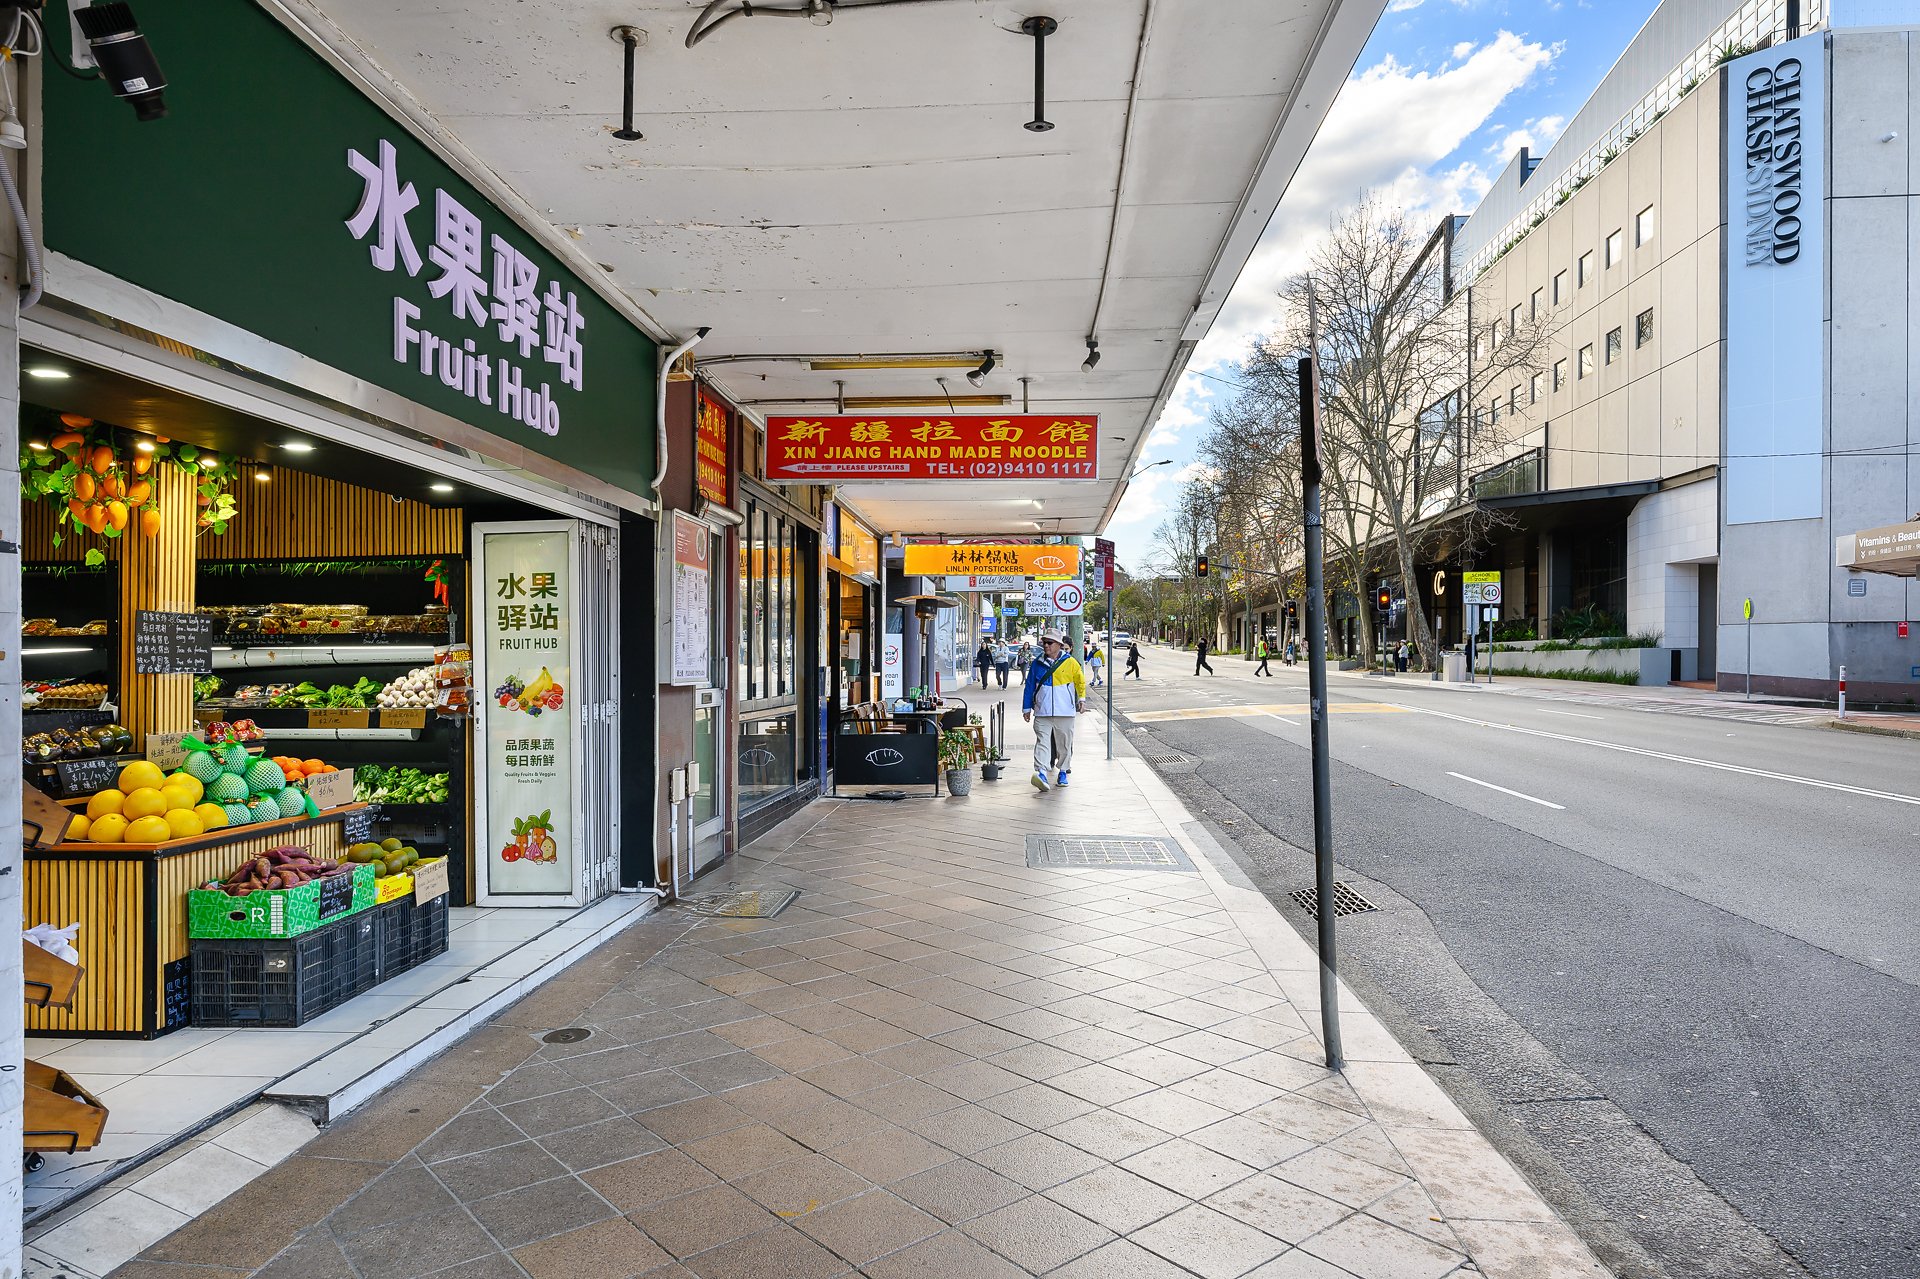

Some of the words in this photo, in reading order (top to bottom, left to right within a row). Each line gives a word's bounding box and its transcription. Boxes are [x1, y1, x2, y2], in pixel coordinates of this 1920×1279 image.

[1745, 67, 1773, 170] CHASE
[1773, 57, 1802, 265] CHATSWOOD
[1746, 166, 1773, 267] SYDNEY
[345, 139, 585, 391] 水果驿站
[393, 297, 492, 405] Fruit
[498, 358, 560, 436] Hub
[784, 446, 816, 459] XIN
[824, 446, 881, 459] JIANG
[889, 446, 941, 459] HAND
[949, 446, 1002, 459] MADE
[1009, 446, 1087, 459] NOODLE
[926, 462, 965, 475] TEL:
[969, 462, 1046, 477] (02)9410
[1051, 462, 1092, 475] 1117
[1859, 535, 1891, 548] Vitamins
[1892, 534, 1897, 543] &
[951, 549, 1019, 565] 林林锅贴
[945, 565, 970, 573] LINLIN
[973, 565, 1024, 573] POTSTICKERS
[497, 572, 558, 599] 水果
[1484, 588, 1498, 597] 40
[1058, 591, 1078, 604] 40
[497, 603, 559, 631] 驿站
[499, 638, 531, 650] FRUIT
[534, 638, 558, 649] HUB
[505, 738, 555, 751] 品质果蔬
[505, 754, 555, 767] 每日新鲜
